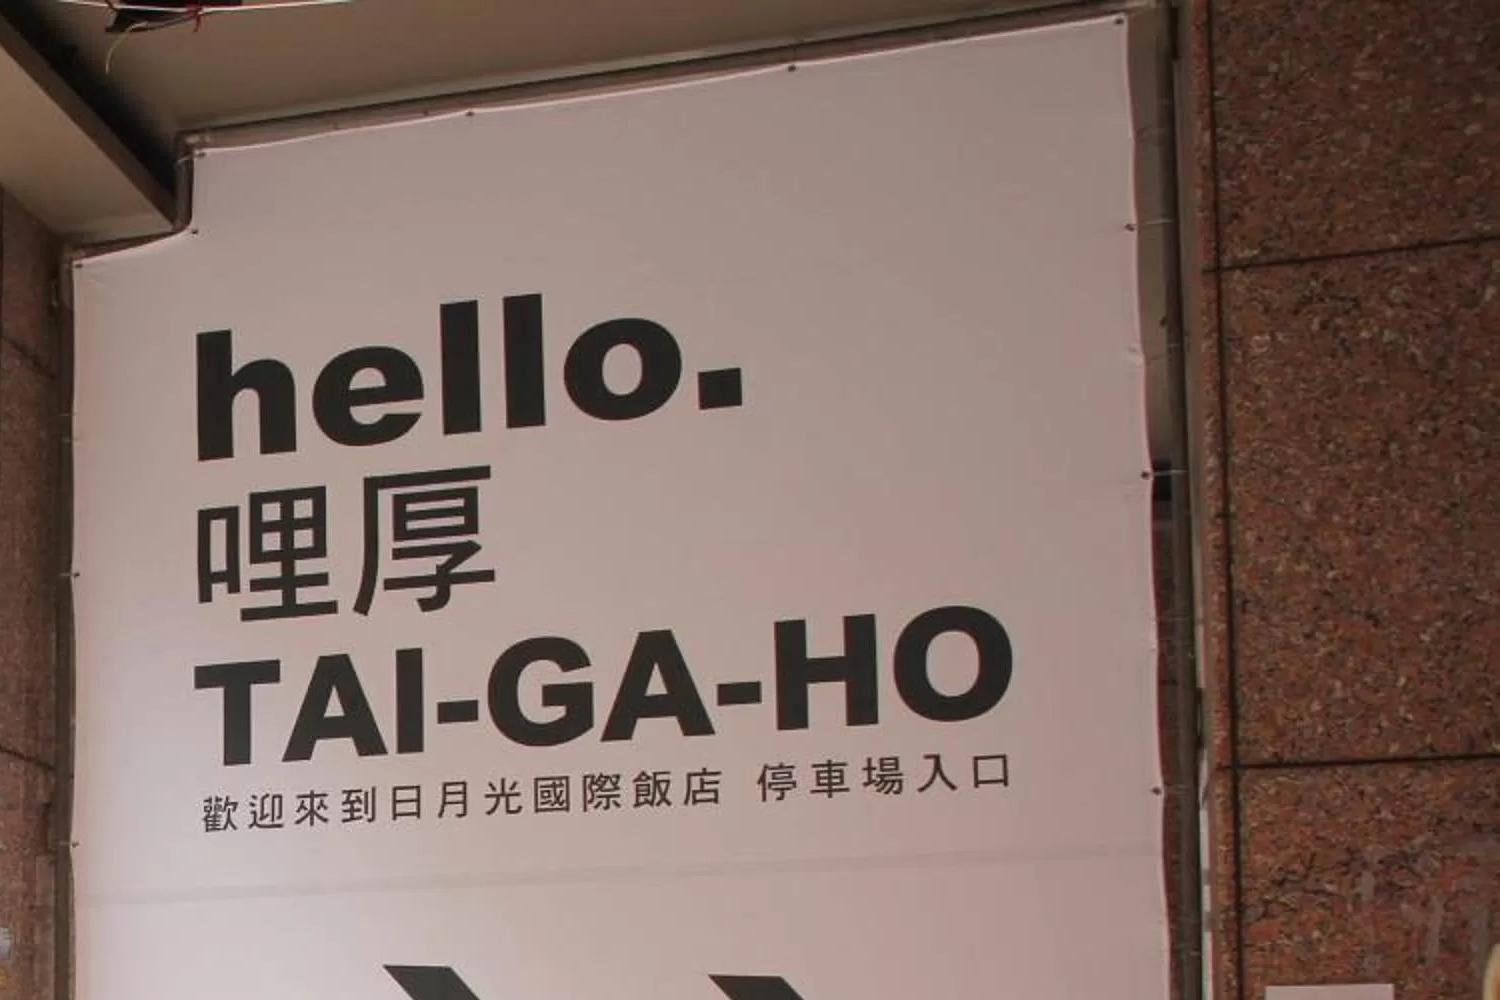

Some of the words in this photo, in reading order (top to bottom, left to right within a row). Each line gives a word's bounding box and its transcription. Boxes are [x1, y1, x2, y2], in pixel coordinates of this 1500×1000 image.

[196, 293, 743, 461] hello.
[197, 464, 496, 622] 哩厚
[194, 605, 1013, 766] TAI-GA-HO
[202, 767, 722, 833] 歡迎來到日月光國際飯店
[757, 753, 1010, 803] 停車場入口
